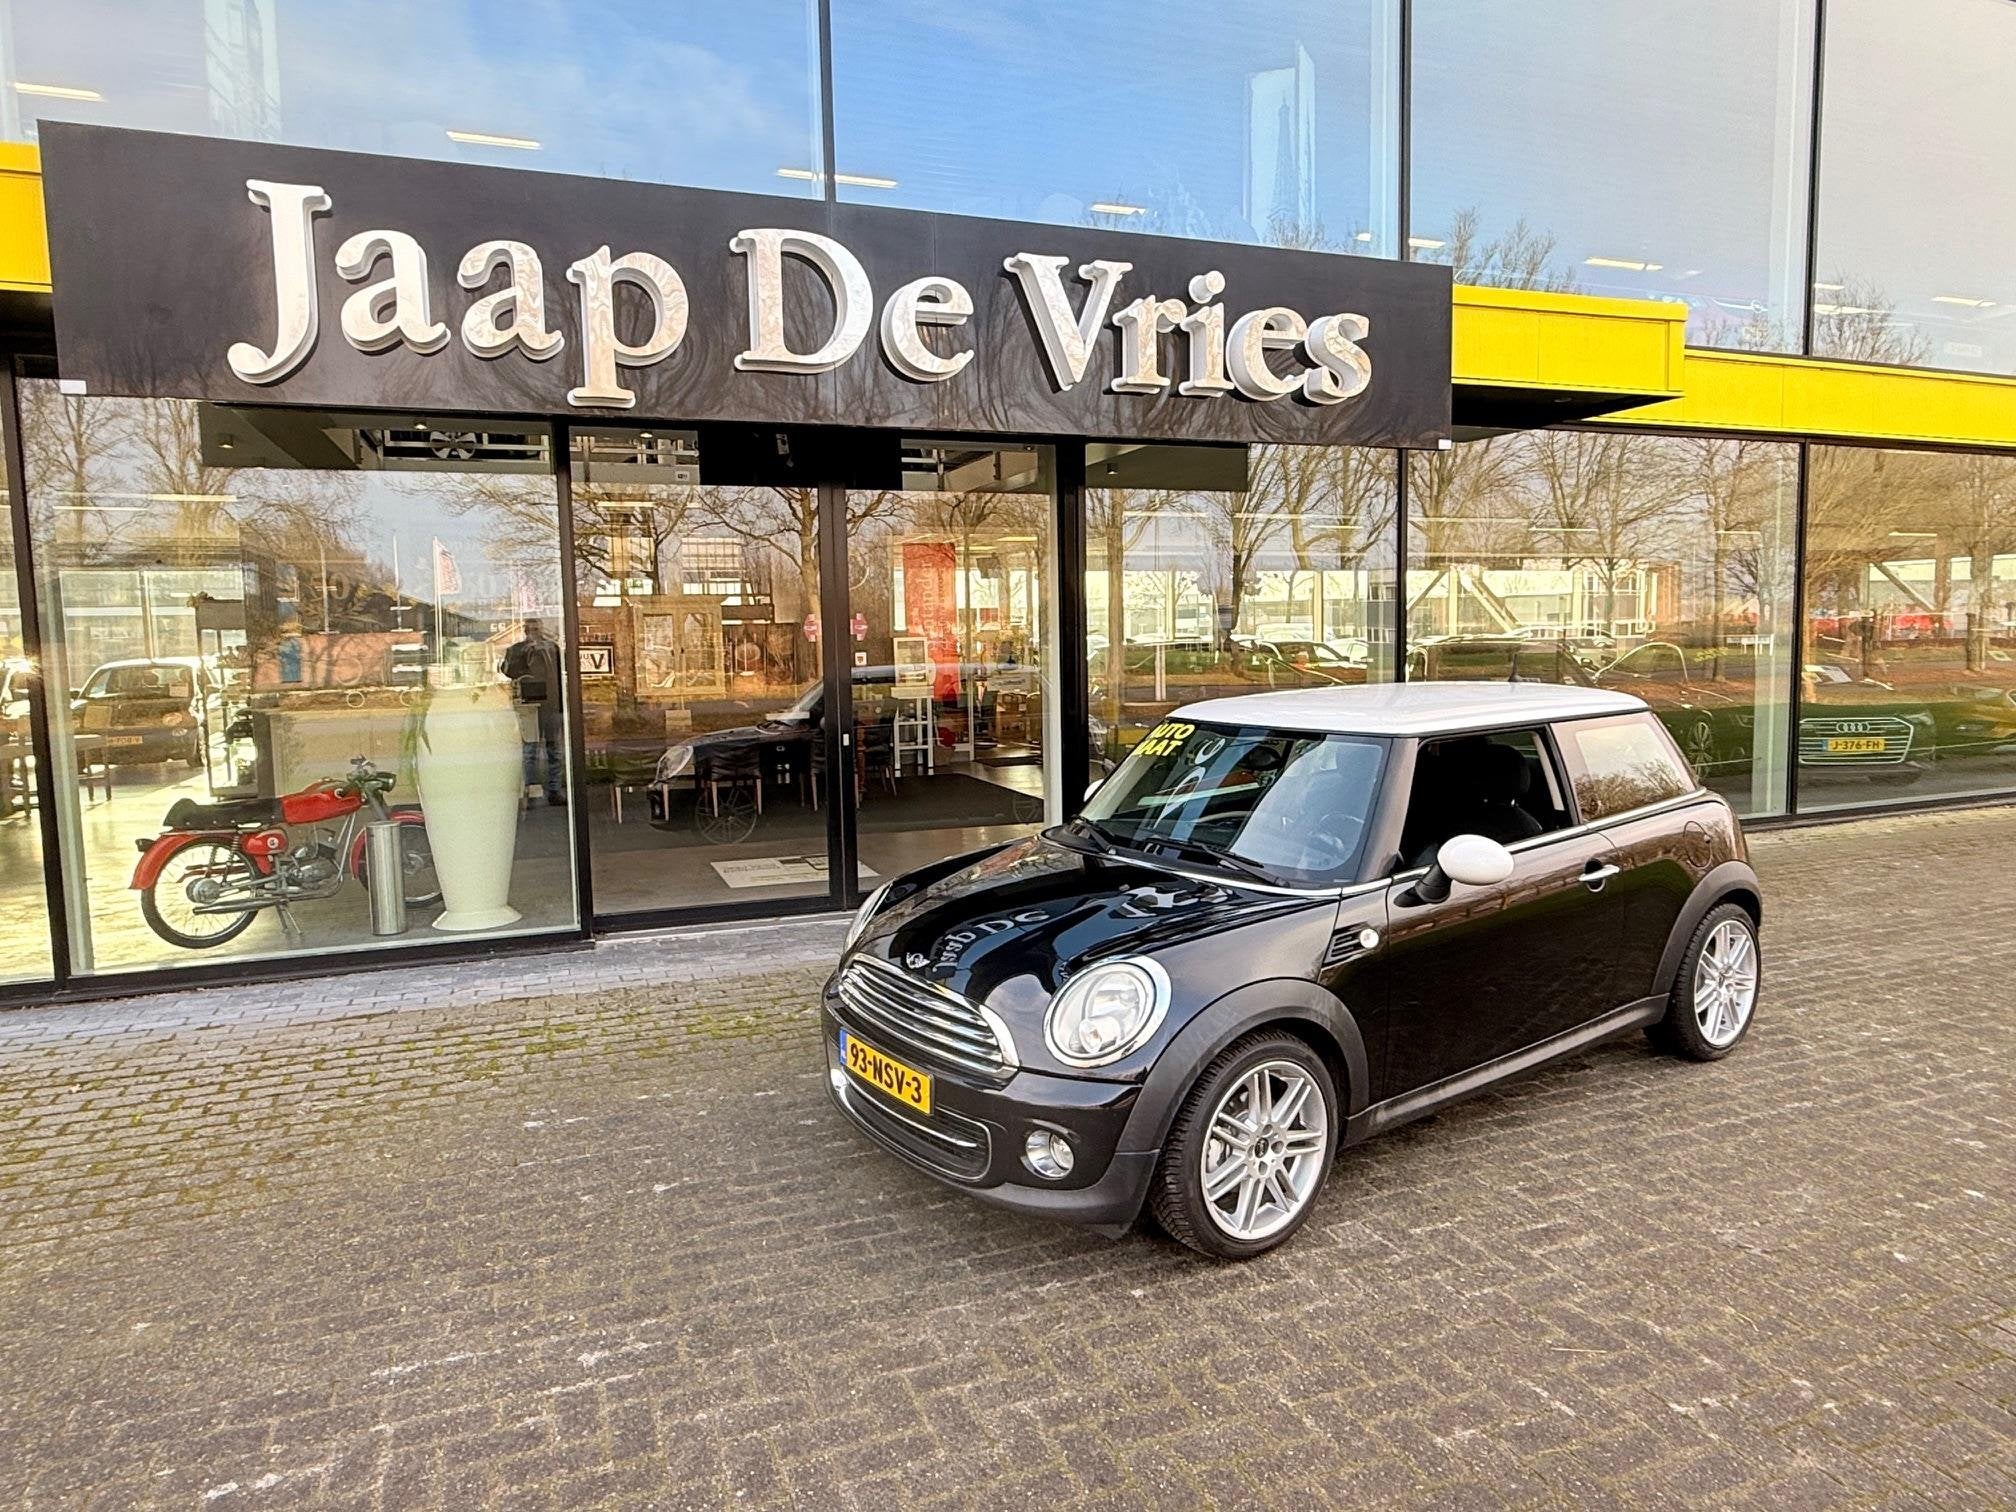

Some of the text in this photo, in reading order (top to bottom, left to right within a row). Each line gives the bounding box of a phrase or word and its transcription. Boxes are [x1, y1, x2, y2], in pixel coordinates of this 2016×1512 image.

[227, 179, 1374, 409] Jaap De Vries
[1832, 741, 1880, 750] J-376-FH
[850, 1042, 922, 1104] 93-NSV-3
